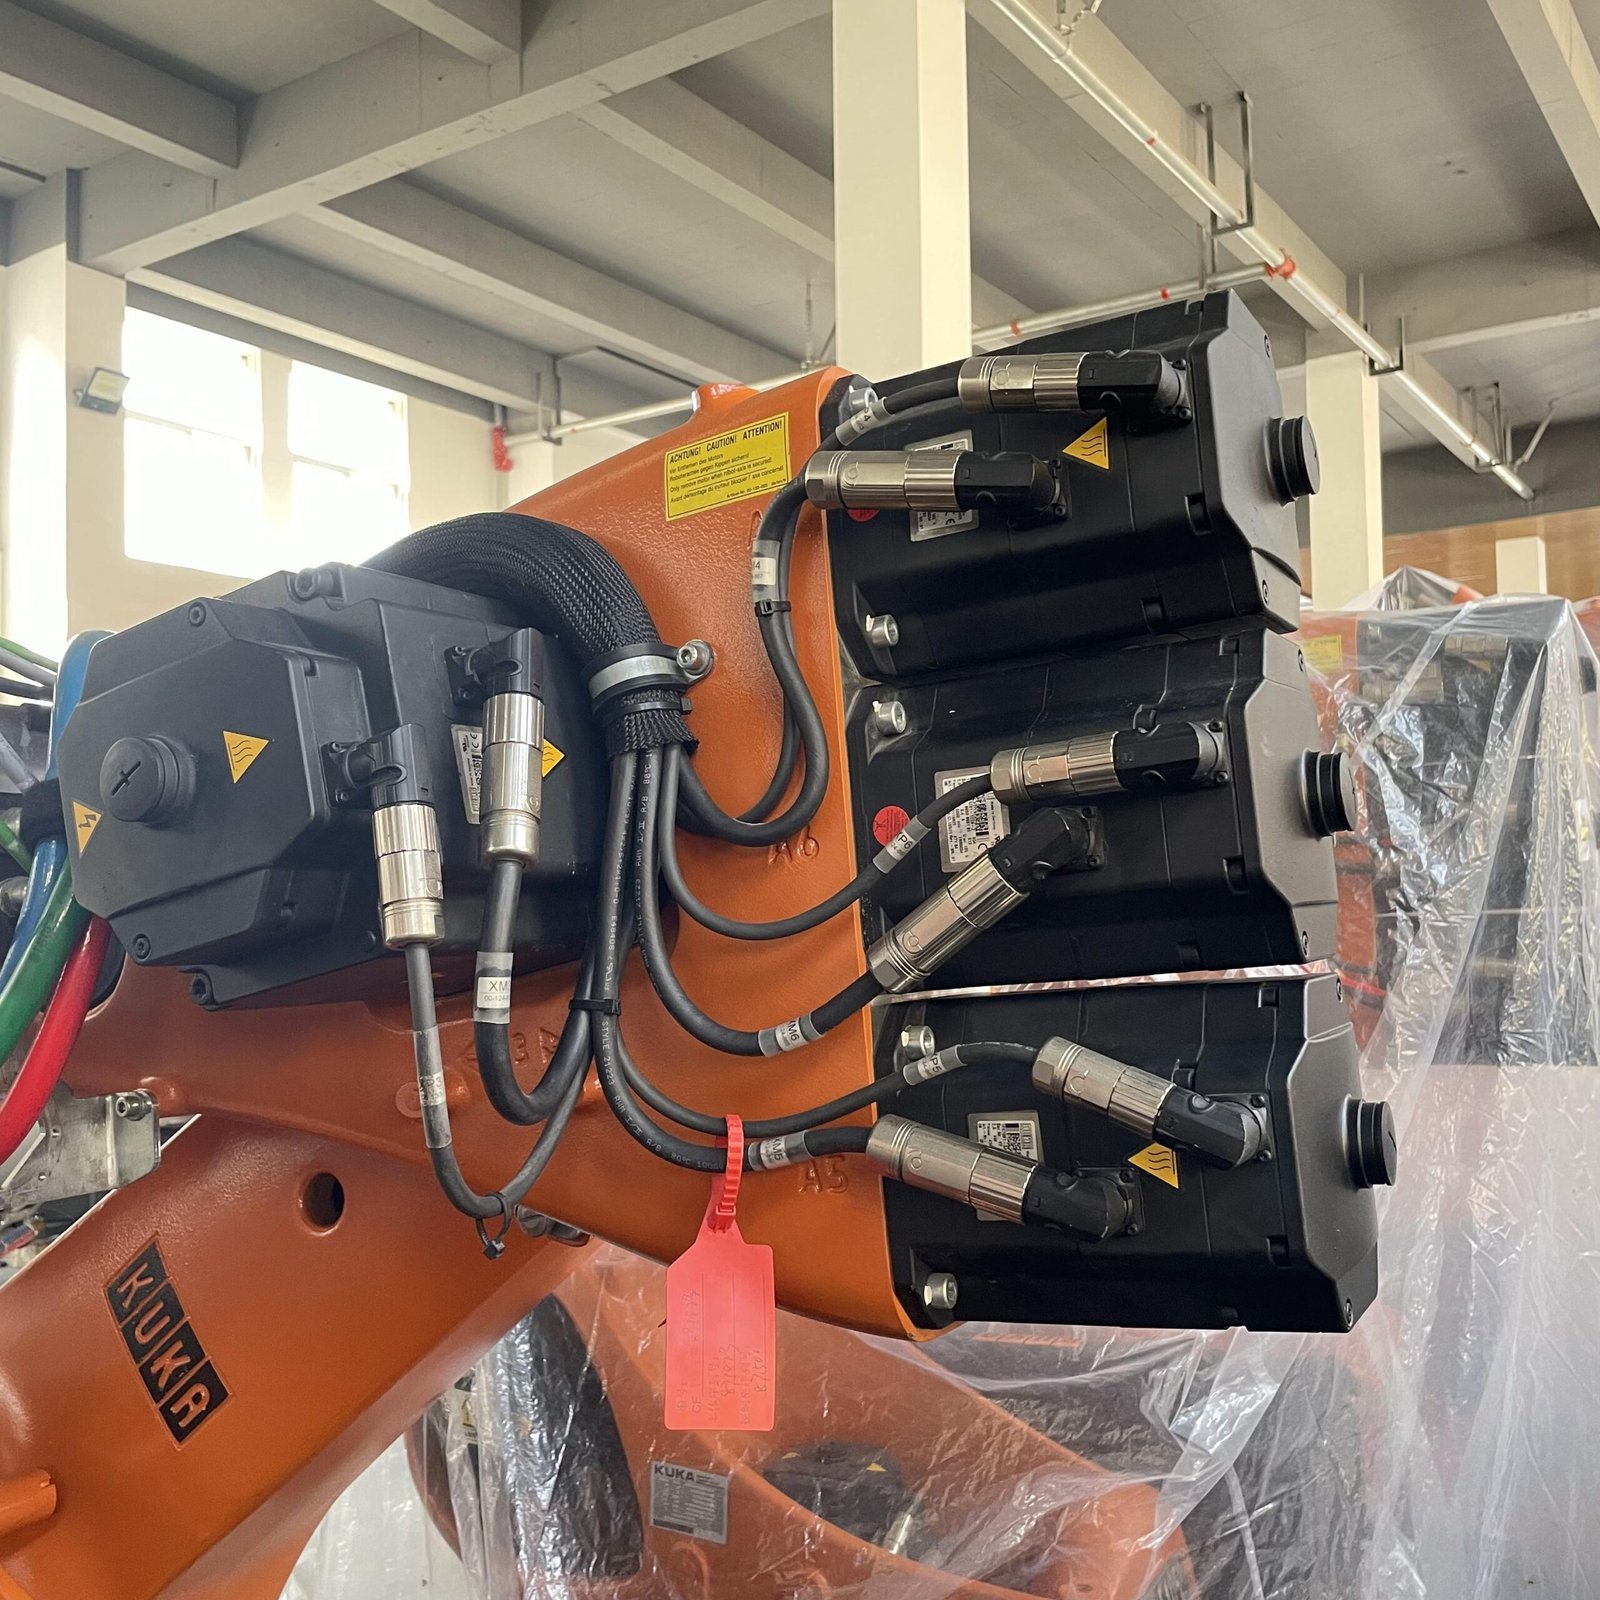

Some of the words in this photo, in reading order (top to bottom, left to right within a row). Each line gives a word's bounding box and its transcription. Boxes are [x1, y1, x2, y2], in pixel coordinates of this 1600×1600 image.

[669, 447, 701, 464] ACHTUNG!
[706, 434, 737, 452] CAUTION!
[742, 420, 782, 440] ATTENTION!
[602, 1020, 610, 1050] STYLE
[604, 1056, 615, 1086] 21223
[614, 1095, 627, 1114] AWM
[646, 1138, 662, 1152] A/B
[115, 1261, 212, 1429] KUKA
[654, 1464, 695, 1482] KUKA
